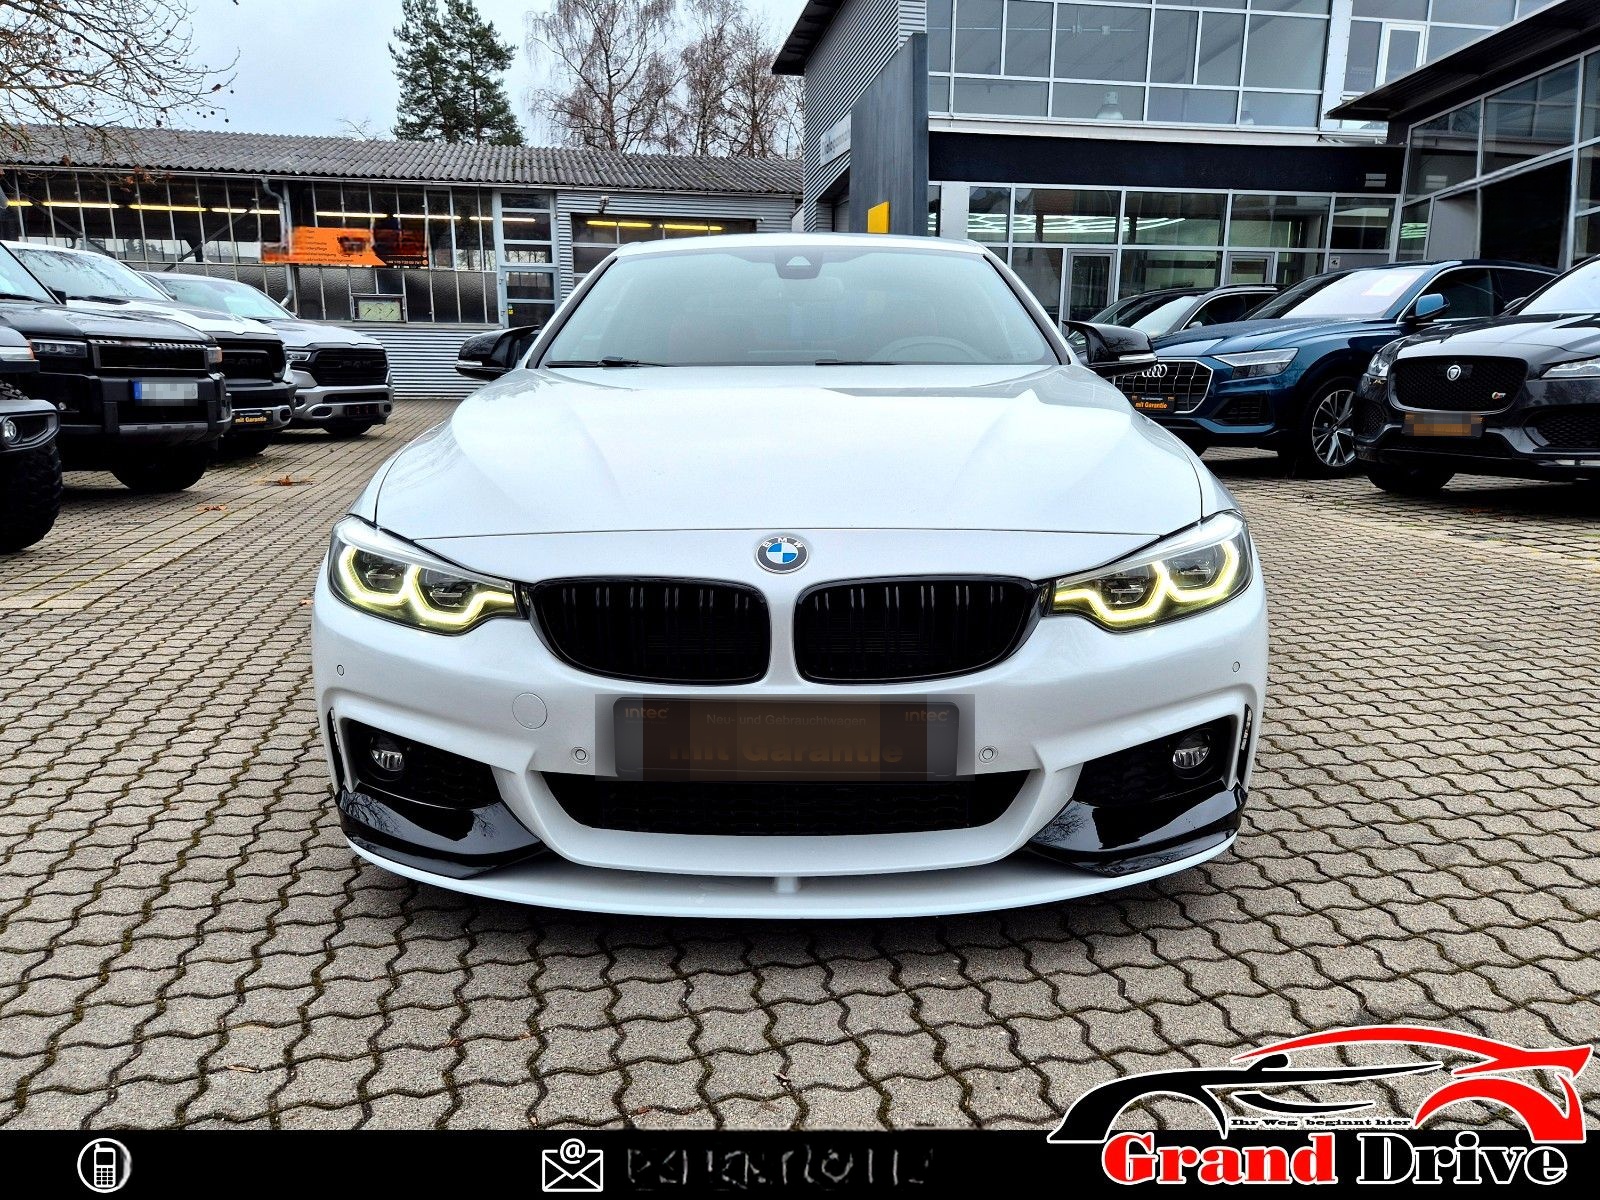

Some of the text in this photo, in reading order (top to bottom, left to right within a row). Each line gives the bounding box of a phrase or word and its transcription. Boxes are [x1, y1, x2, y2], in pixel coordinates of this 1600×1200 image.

[762, 537, 804, 548] BMW
[706, 713, 866, 729] Neu- und Gebrauchtwagen
[742, 738, 904, 763] Garantie
